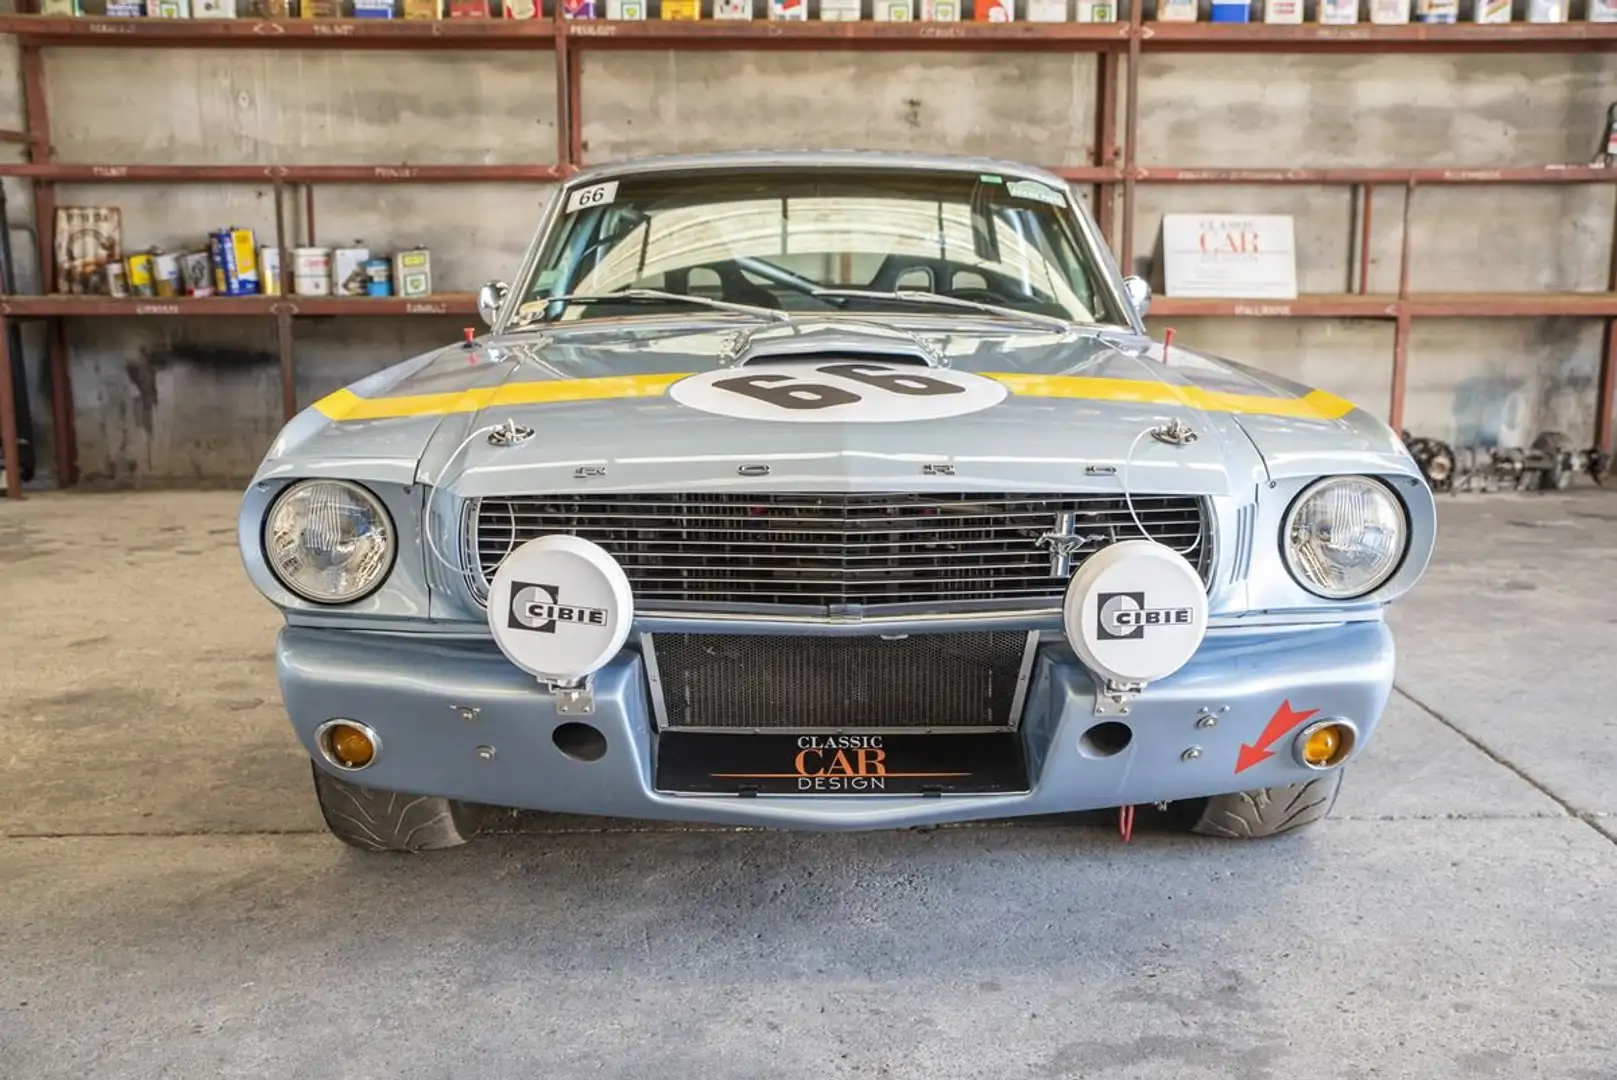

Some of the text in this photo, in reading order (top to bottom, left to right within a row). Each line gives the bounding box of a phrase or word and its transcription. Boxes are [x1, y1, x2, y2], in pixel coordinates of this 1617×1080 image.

[579, 187, 605, 206] 66
[1199, 231, 1259, 254] CAR
[711, 363, 966, 410] 66
[797, 735, 883, 749] CLASSIC
[794, 748, 886, 777] CAR
[797, 776, 885, 790] DESIGN
